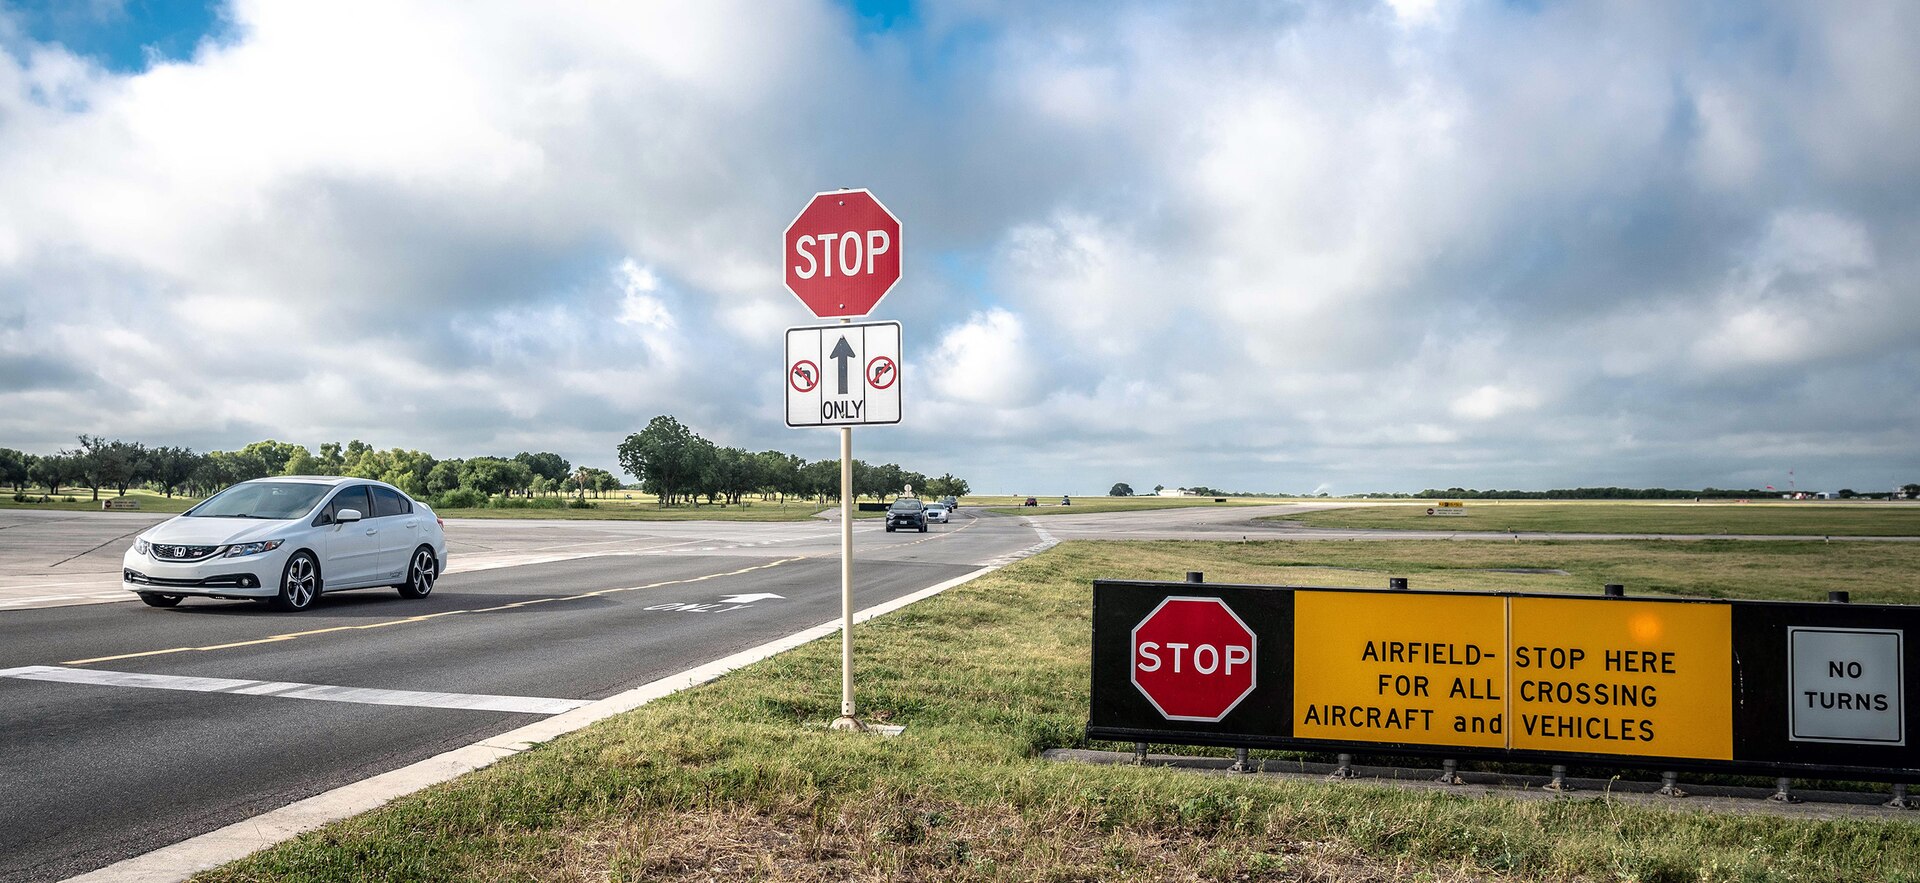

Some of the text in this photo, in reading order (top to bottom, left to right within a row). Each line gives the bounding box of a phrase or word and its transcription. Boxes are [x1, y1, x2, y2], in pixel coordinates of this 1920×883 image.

[795, 229, 890, 280] STOP
[823, 399, 863, 420] ONLY
[643, 603, 754, 613] ONLY
[1138, 641, 1250, 675] STOP
[1361, 640, 1676, 674] AIRFIELD- STOP HERE
[1829, 661, 1862, 679] NO
[1378, 674, 1657, 707] FOR ALL CROSSING
[1804, 691, 1889, 711] TURNS
[1304, 704, 1655, 742] AIRCRAFT and VEHICLES
